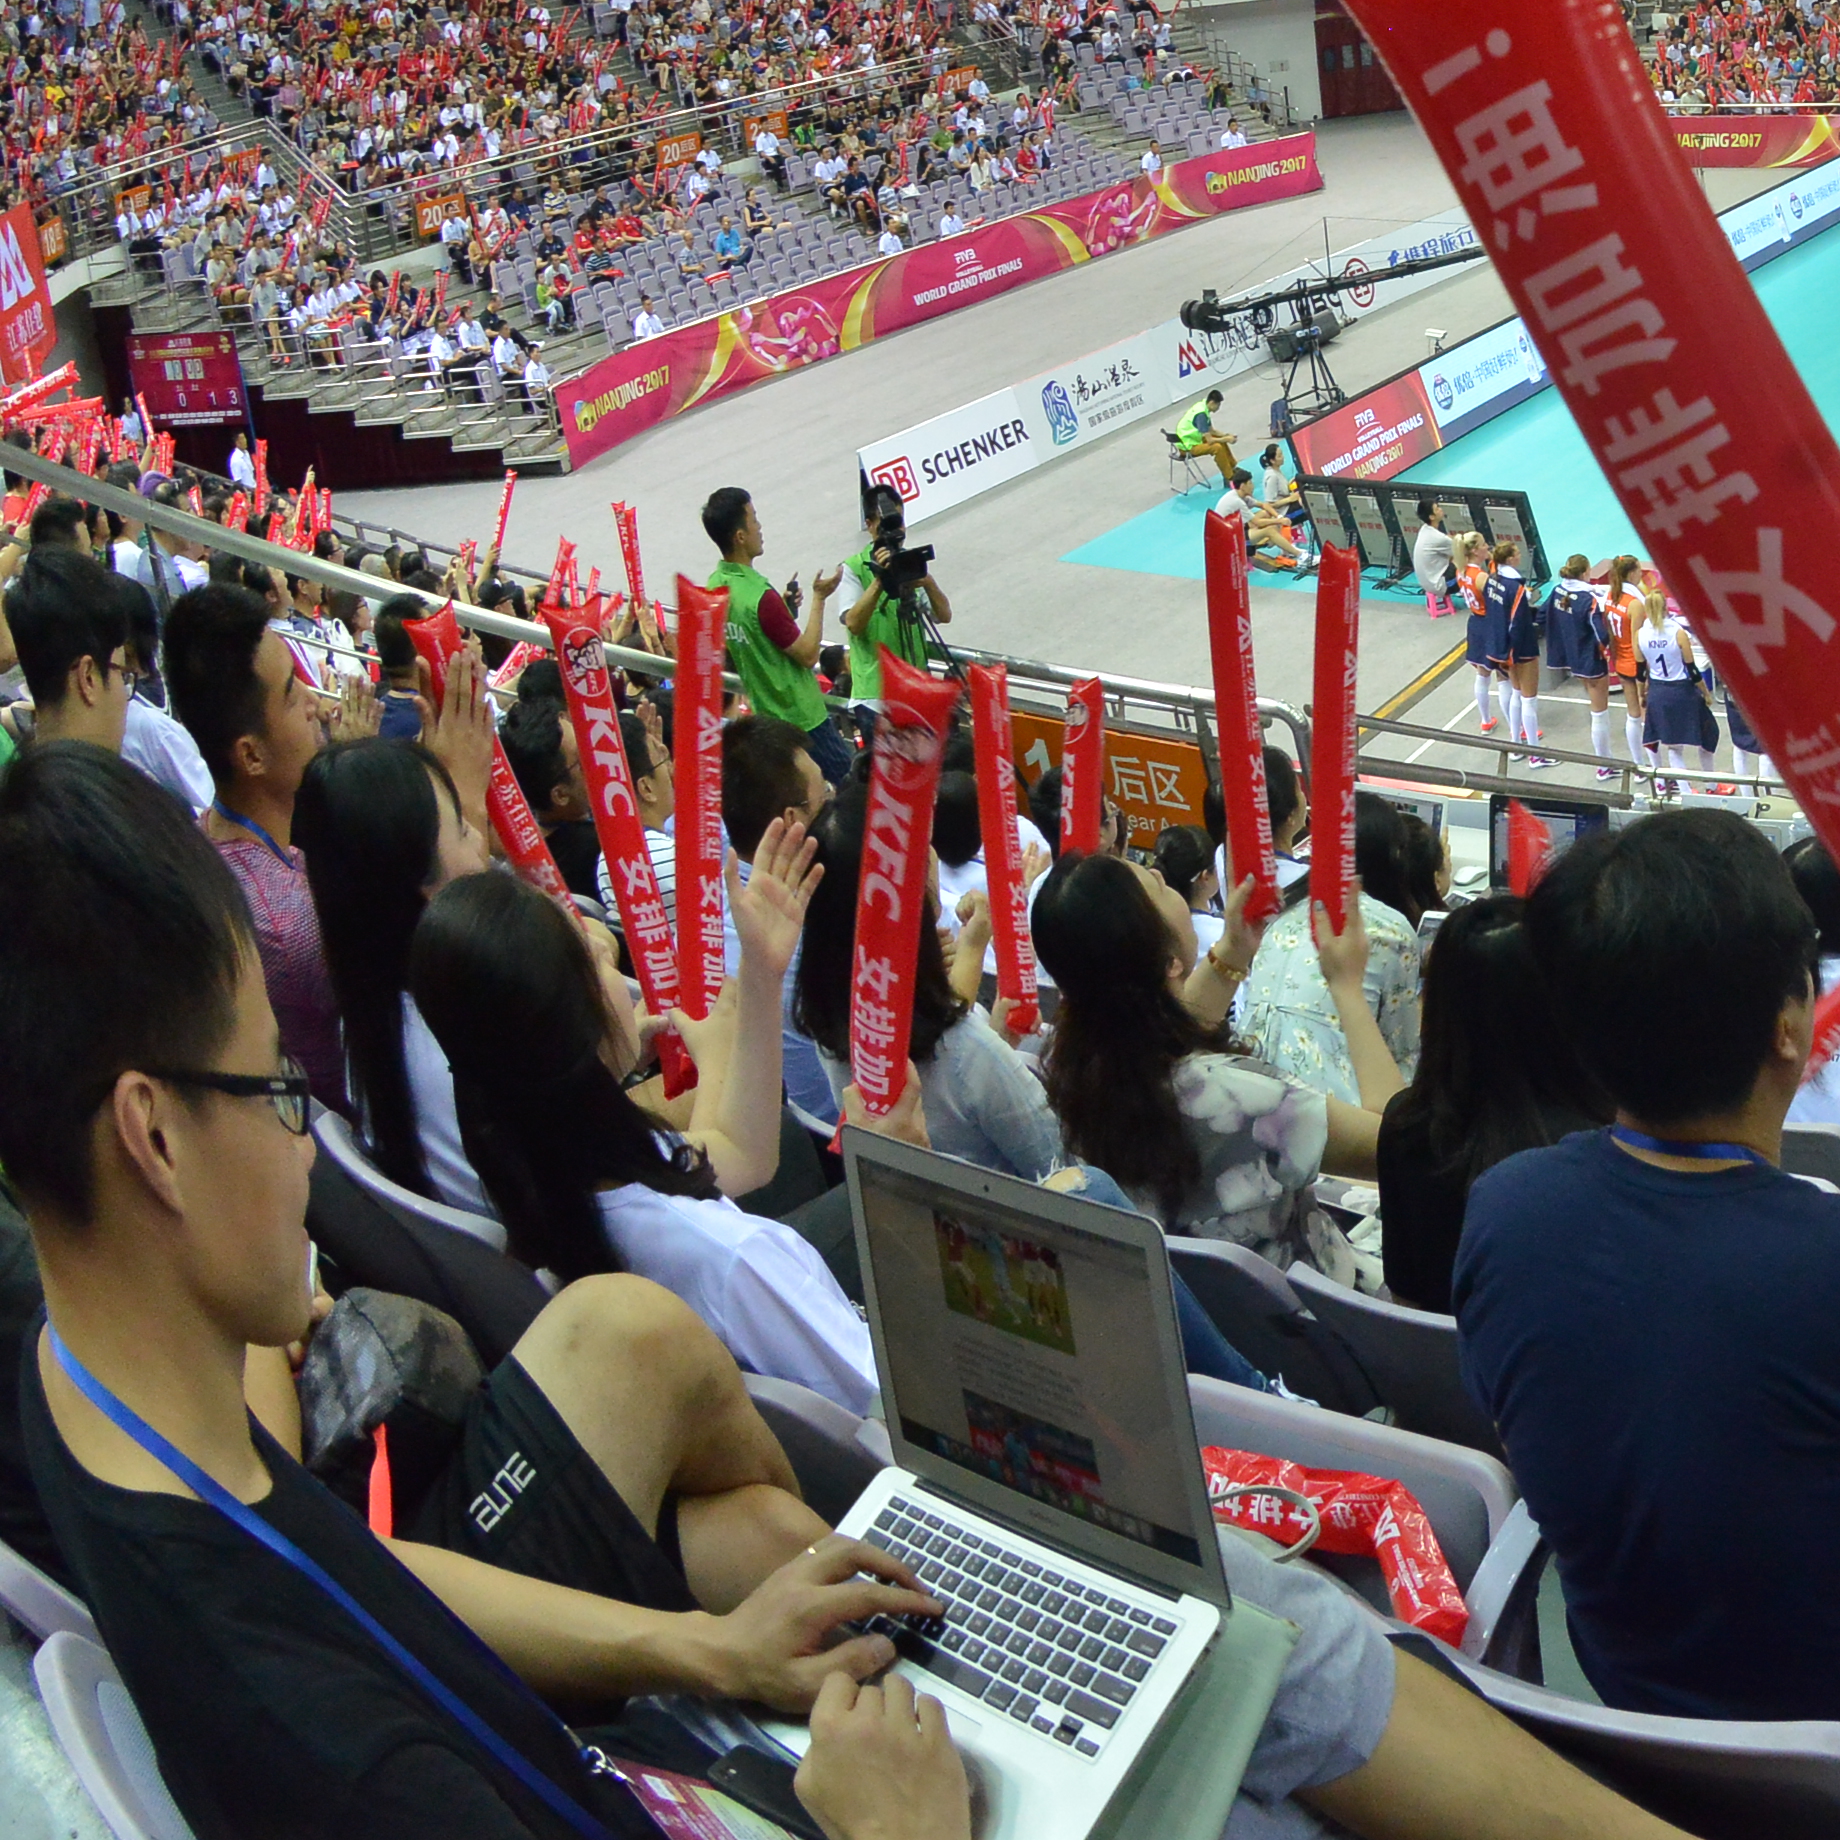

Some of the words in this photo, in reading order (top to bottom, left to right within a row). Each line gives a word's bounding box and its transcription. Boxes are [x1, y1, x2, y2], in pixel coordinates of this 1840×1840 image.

[1731, 133, 1762, 148] 2017
[1228, 162, 1278, 187] NANJING
[1280, 155, 1306, 175] 2017
[423, 207, 442, 230] 20
[954, 248, 976, 264] FIVB
[914, 280, 946, 307] WORLD
[948, 274, 978, 296] GRAND
[978, 266, 998, 285] PRIX
[999, 257, 1022, 276] FINALS
[1423, 29, 1838, 677] 女排加油!
[1354, 409, 1375, 427] FIVB
[921, 419, 1030, 484] SCHENKER
[1321, 453, 1353, 476] WORLD
[1352, 437, 1380, 461] GRAND
[1380, 428, 1398, 446] PRIX
[1398, 413, 1423, 437] FINALS
[1608, 611, 1622, 638] 17
[1648, 640, 1668, 648] KNIP
[1655, 654, 1668, 677] 1
[583, 702, 634, 817] KFC
[1061, 752, 1075, 835] KFC
[1110, 756, 1191, 810] 后区
[864, 786, 913, 922] KFC
